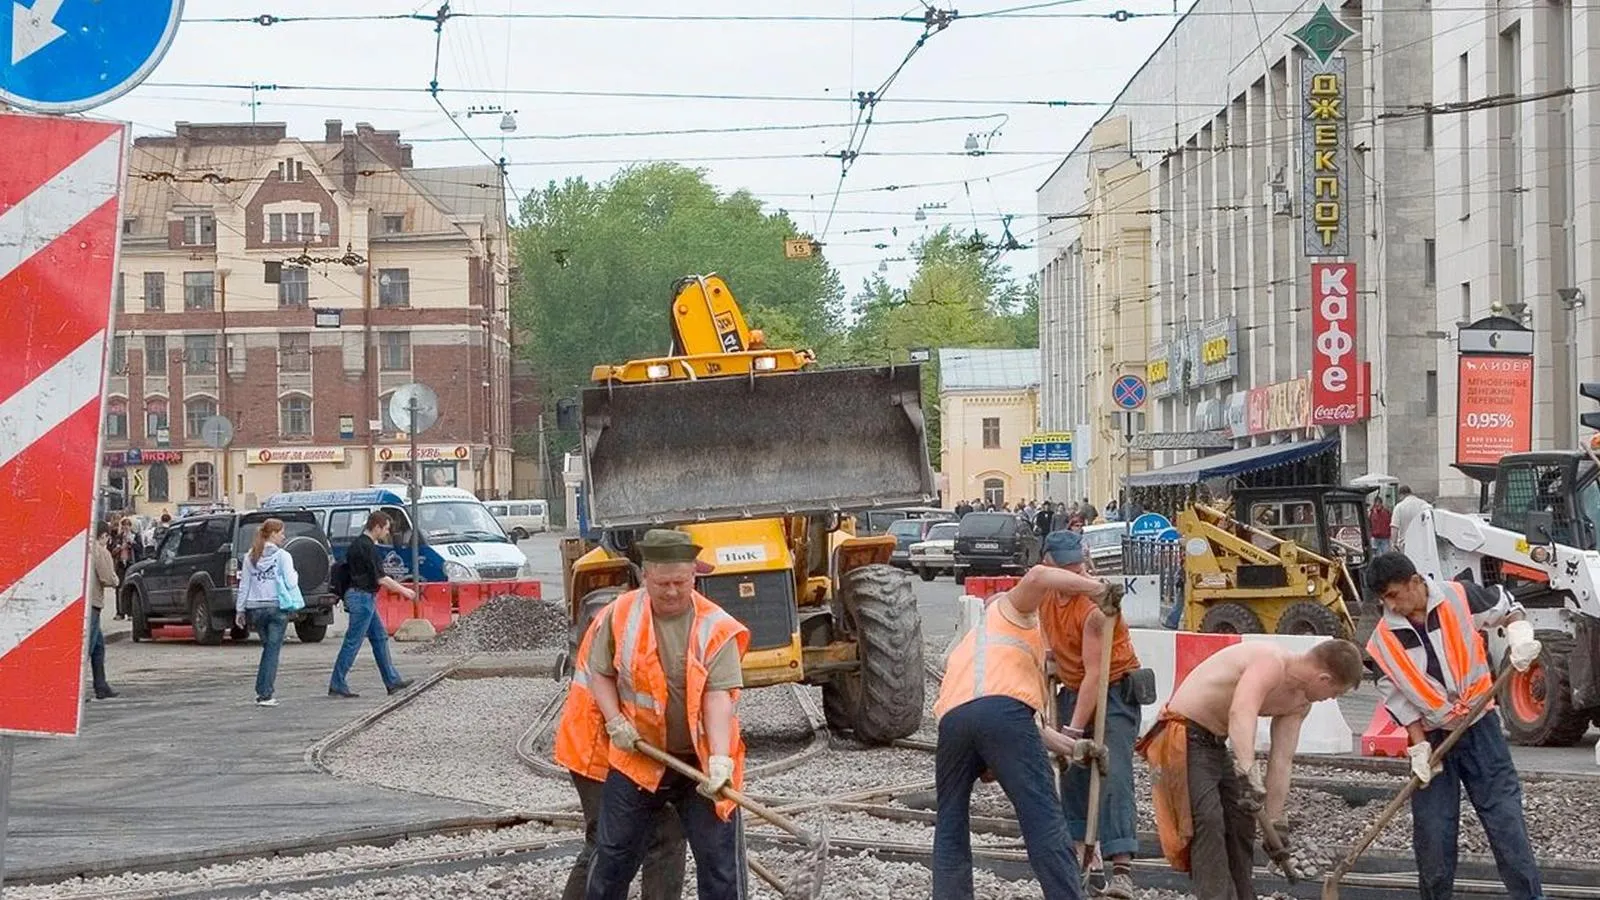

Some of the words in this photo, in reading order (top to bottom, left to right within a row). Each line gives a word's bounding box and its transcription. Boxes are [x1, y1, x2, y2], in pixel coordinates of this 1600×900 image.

[1308, 74, 1343, 246] ДЖЕКПОТ
[1479, 361, 1529, 372] ЛИДЕР
[1467, 412, 1514, 429] 0,95%
[447, 543, 476, 557] 400
